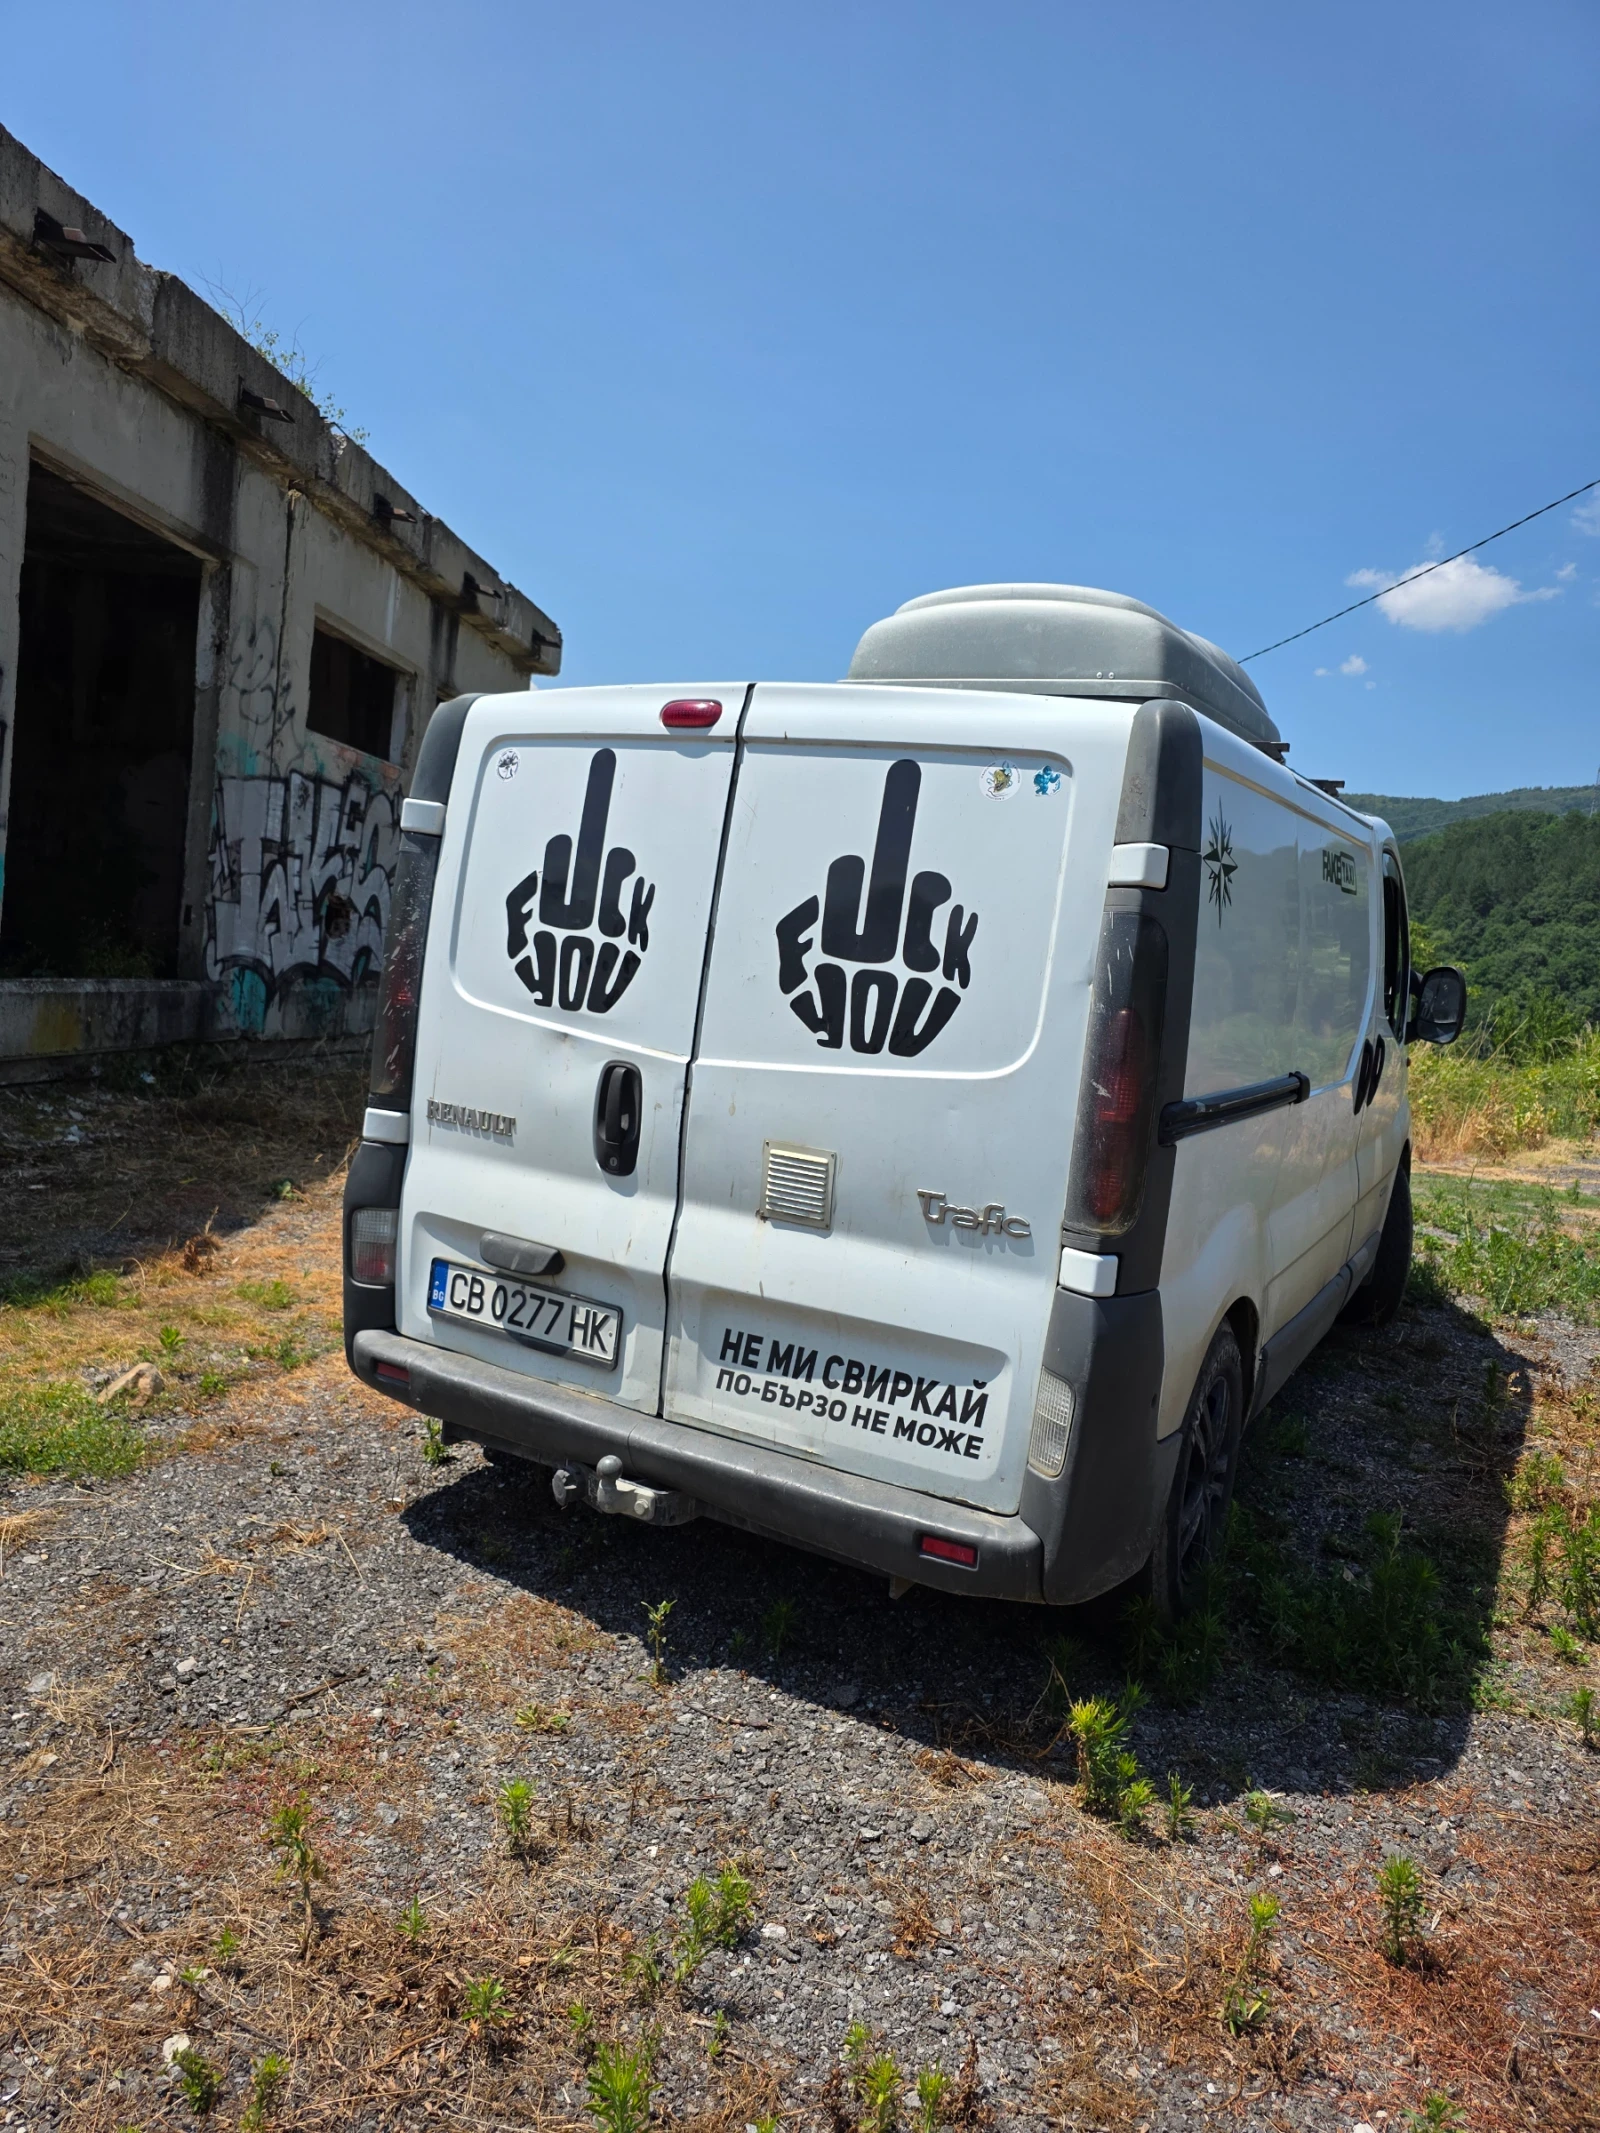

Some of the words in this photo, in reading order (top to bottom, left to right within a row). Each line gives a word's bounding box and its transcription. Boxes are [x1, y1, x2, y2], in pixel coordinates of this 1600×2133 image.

[506, 748, 656, 959] FUCK
[776, 759, 979, 995] FUCK
[1322, 849, 1341, 885] FAKE
[515, 930, 642, 1013] YOU
[790, 963, 961, 1057] YOU
[426, 1097, 516, 1137] RENAULT
[917, 1188, 1031, 1238] Trafic
[432, 1288, 445, 1302] BG
[491, 1285, 565, 1336] 0277
[716, 1369, 847, 1422] ПО-БЪРЗО
[851, 1404, 891, 1435] НЕ
[893, 1416, 985, 1460] МОЖЕ
[719, 1328, 764, 1369] НЕ
[766, 1339, 819, 1384] МИ
[822, 1355, 990, 1429] СВИРКАЙ
